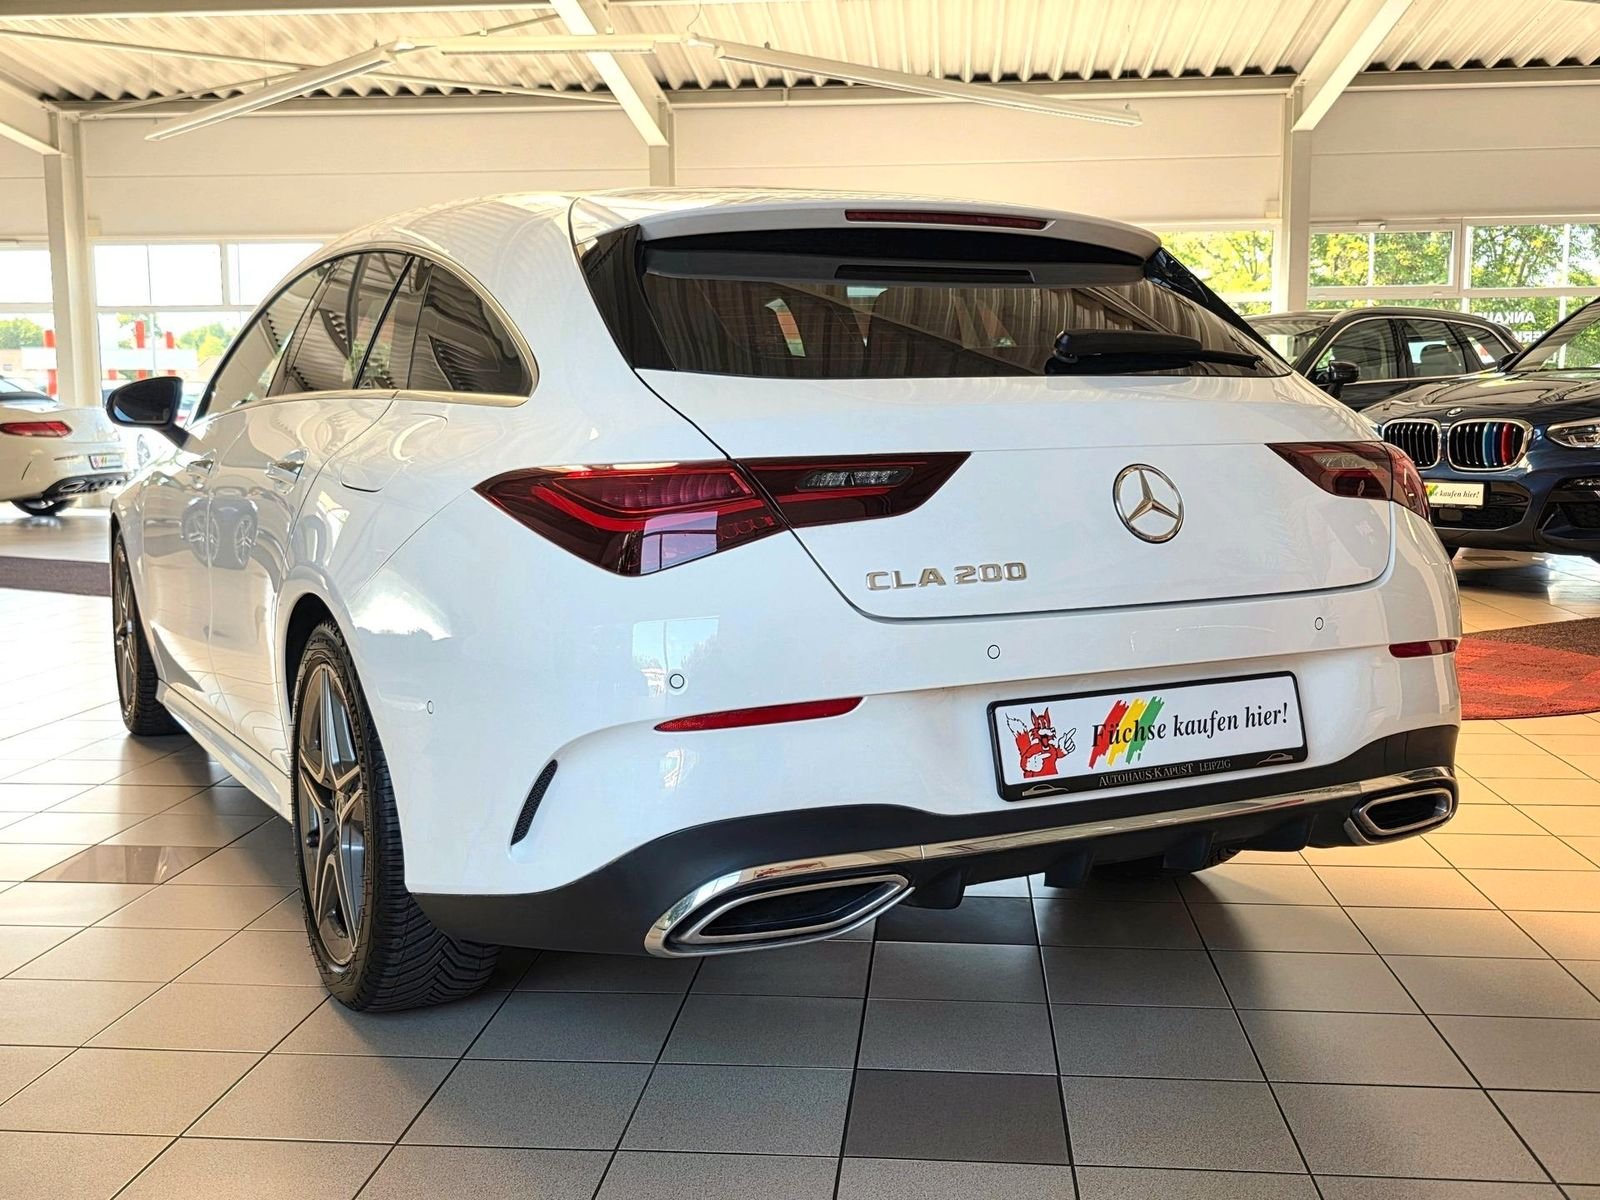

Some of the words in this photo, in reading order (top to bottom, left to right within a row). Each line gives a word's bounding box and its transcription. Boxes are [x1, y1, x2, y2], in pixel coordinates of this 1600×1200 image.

[865, 568, 946, 591] CLA
[953, 562, 1027, 585] 200
[1091, 719, 1167, 748] Füchse
[1173, 709, 1239, 739] kaufen
[1245, 702, 1288, 728] hier!
[1199, 759, 1231, 772] LEIPZIG
